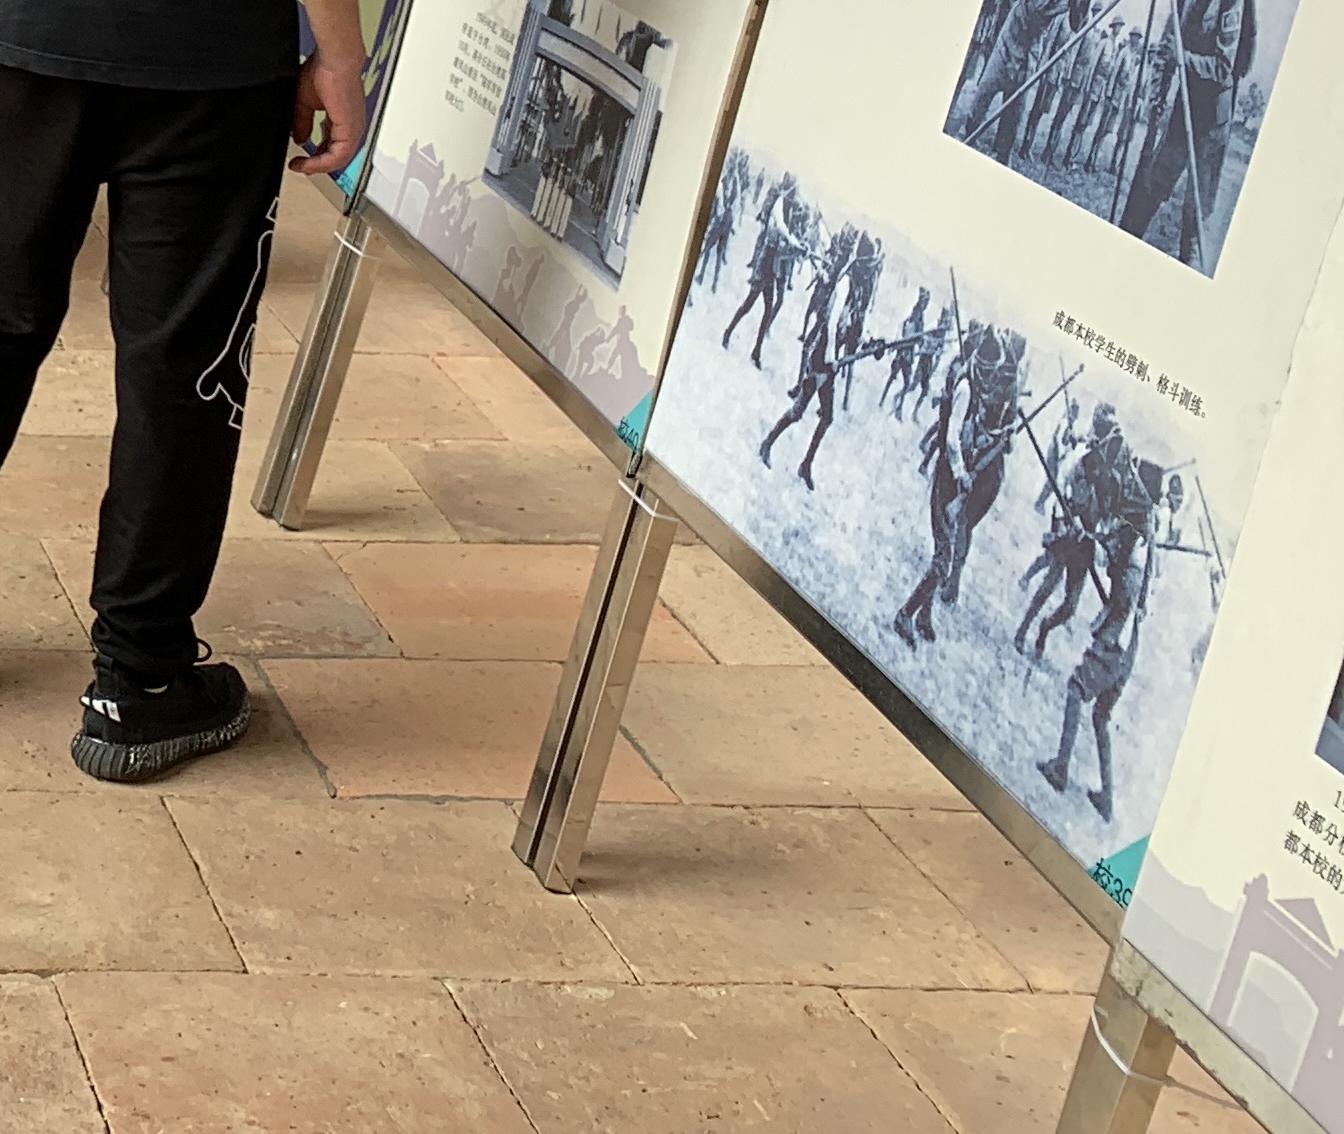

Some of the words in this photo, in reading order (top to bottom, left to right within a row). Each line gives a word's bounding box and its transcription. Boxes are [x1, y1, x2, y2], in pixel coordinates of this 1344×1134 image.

[1052, 310, 1206, 419] 成都本校学生的劈刺、格斗训练。
[1292, 799, 1344, 856] 成都分
